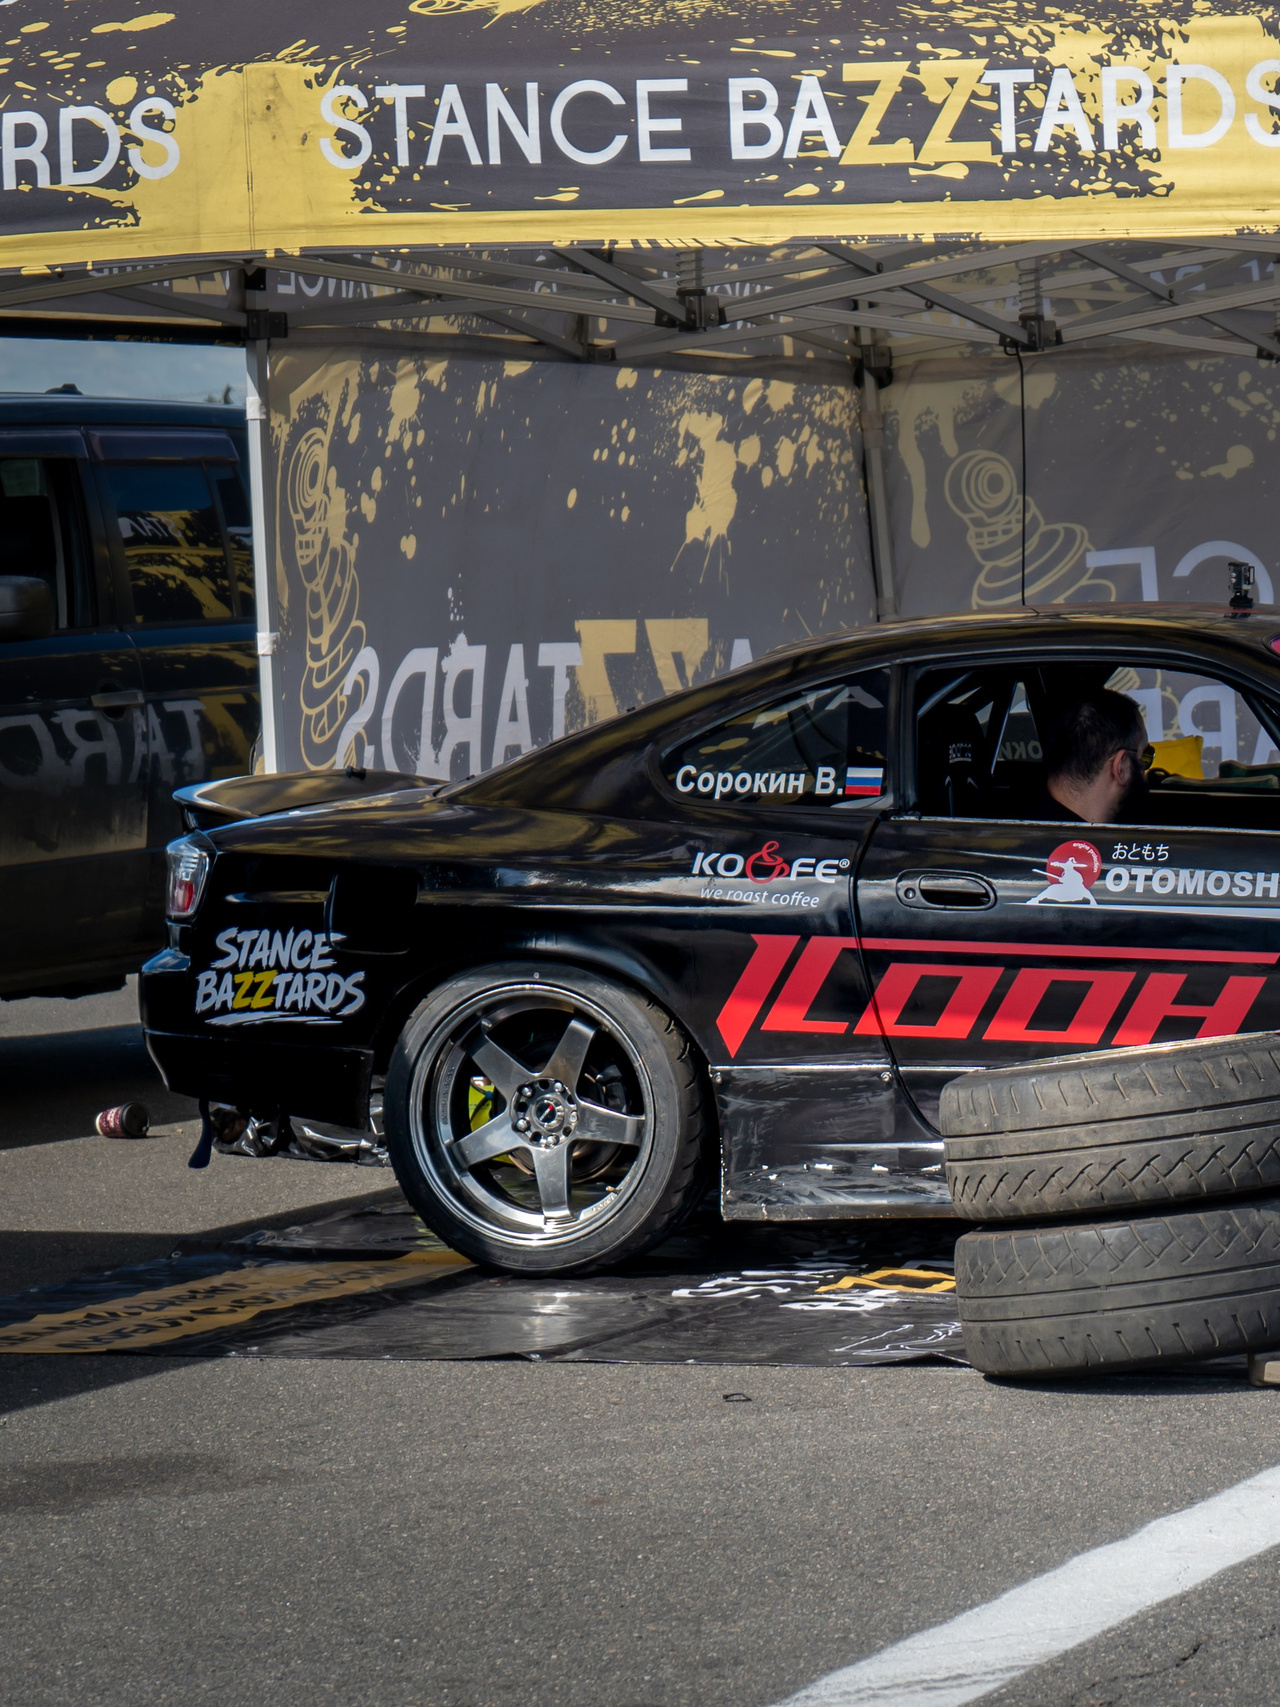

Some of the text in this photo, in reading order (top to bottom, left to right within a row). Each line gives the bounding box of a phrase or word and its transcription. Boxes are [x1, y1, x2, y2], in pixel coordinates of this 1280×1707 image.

[319, 79, 692, 170] STANCE
[675, 764, 843, 800] Сорокин В.
[1111, 842, 1170, 862] おともち
[700, 887, 820, 908] we roast coffee
[211, 926, 348, 971] STANCE
[195, 969, 366, 1016] BAZZTARDS
